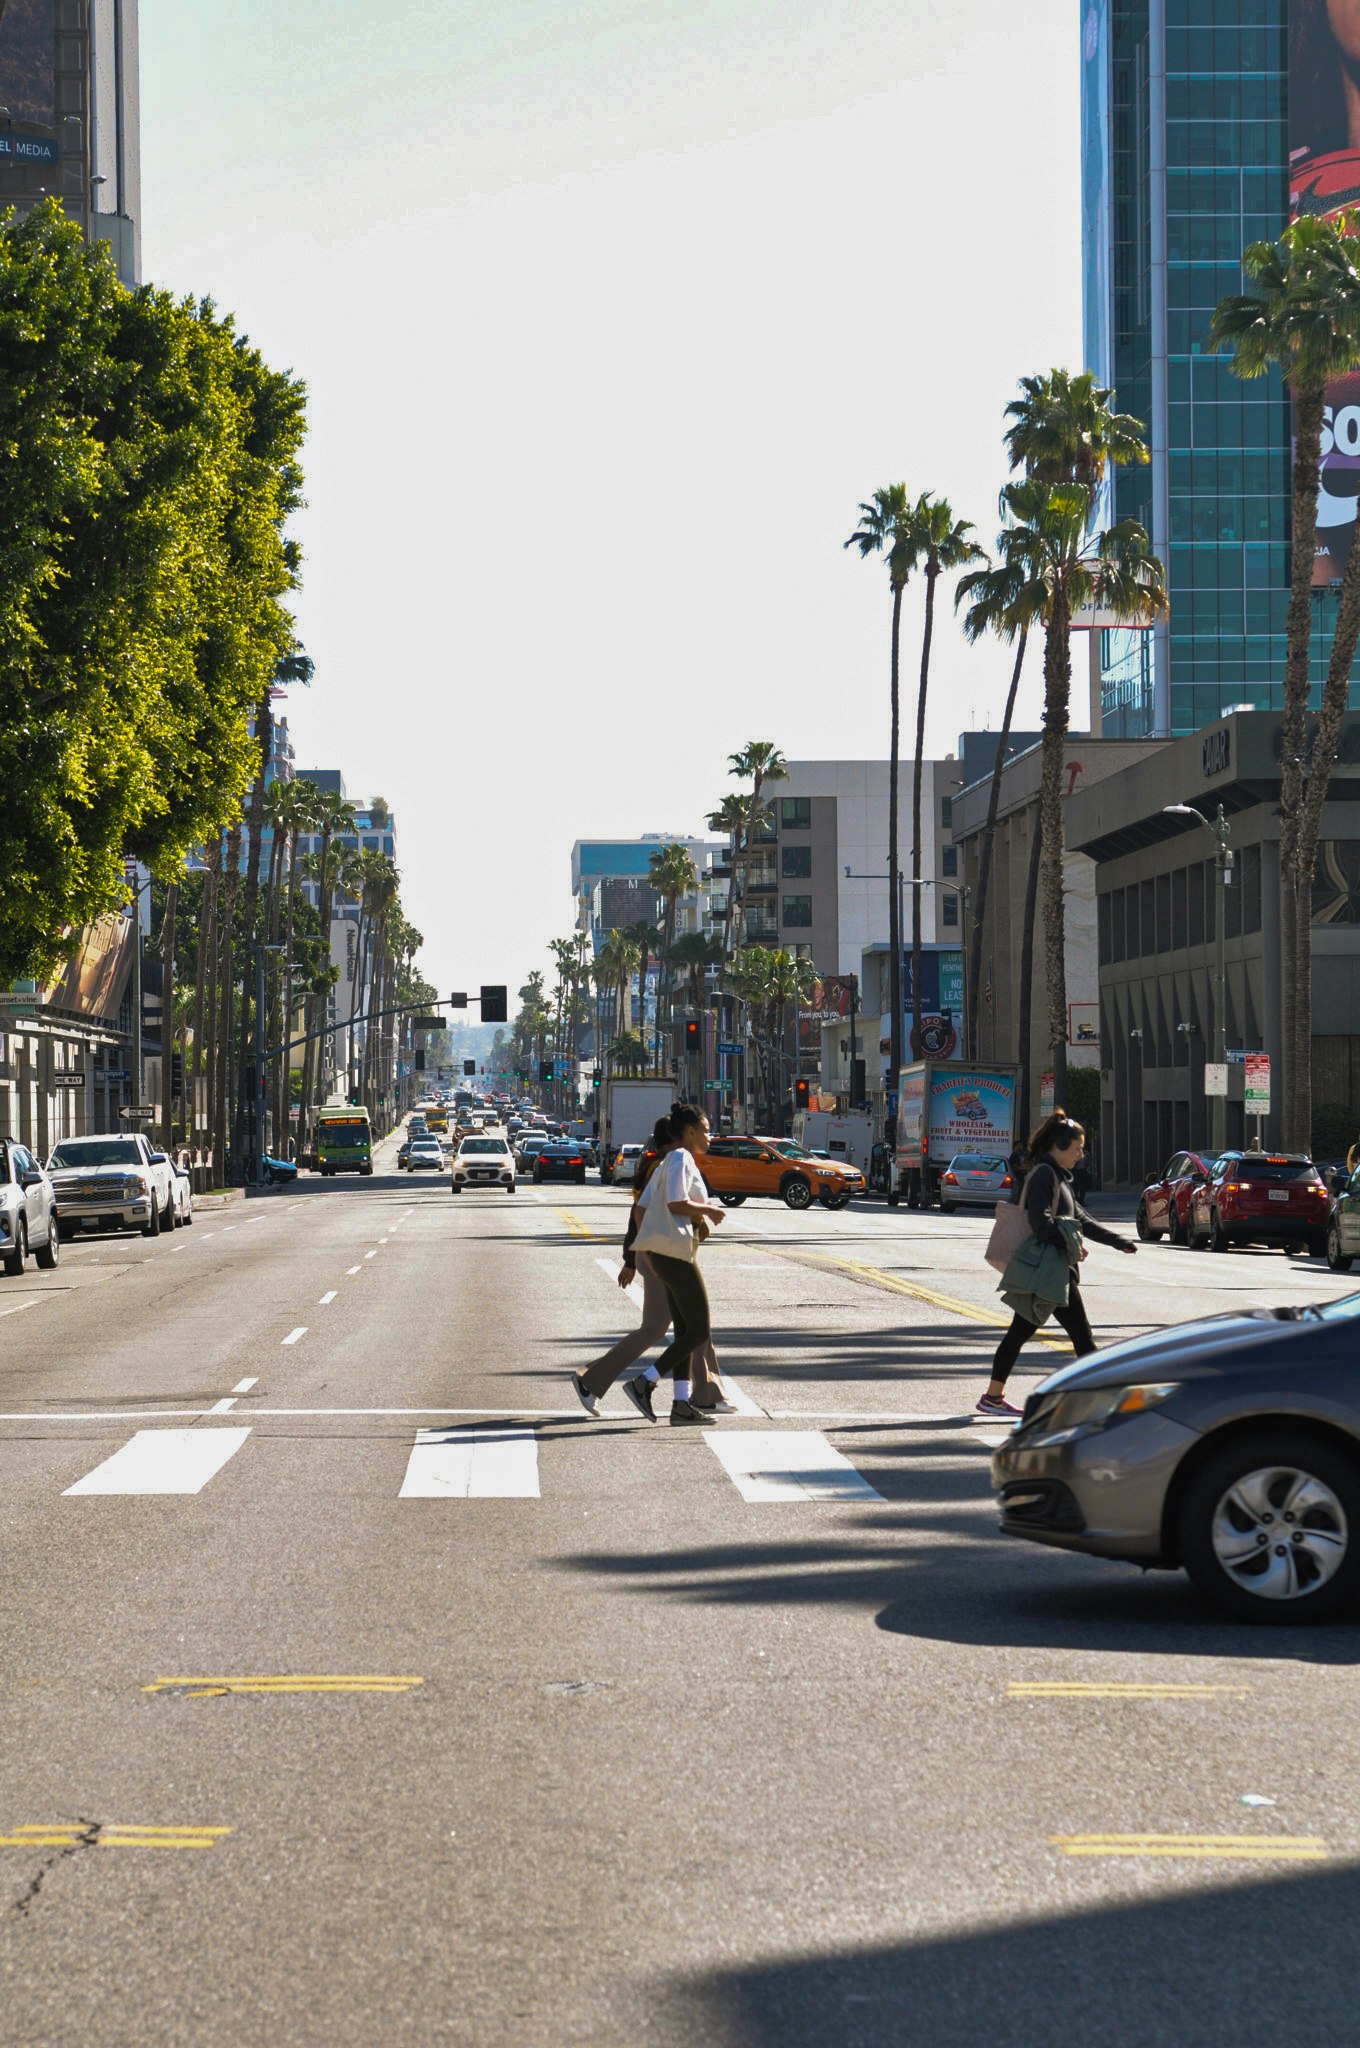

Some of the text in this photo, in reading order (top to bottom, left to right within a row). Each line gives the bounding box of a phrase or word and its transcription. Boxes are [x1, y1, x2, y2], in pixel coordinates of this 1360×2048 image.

[16, 142, 52, 158] MEDIA
[346, 929, 356, 982] NeueHouse
[951, 979, 963, 990] NO
[798, 1010, 812, 1019] From
[931, 1076, 972, 1096] CHARLIE'S
[974, 1076, 1011, 1098] PRODUCE
[930, 1127, 952, 1135] FRUIT
[964, 1128, 1010, 1137] VEGETABLES
